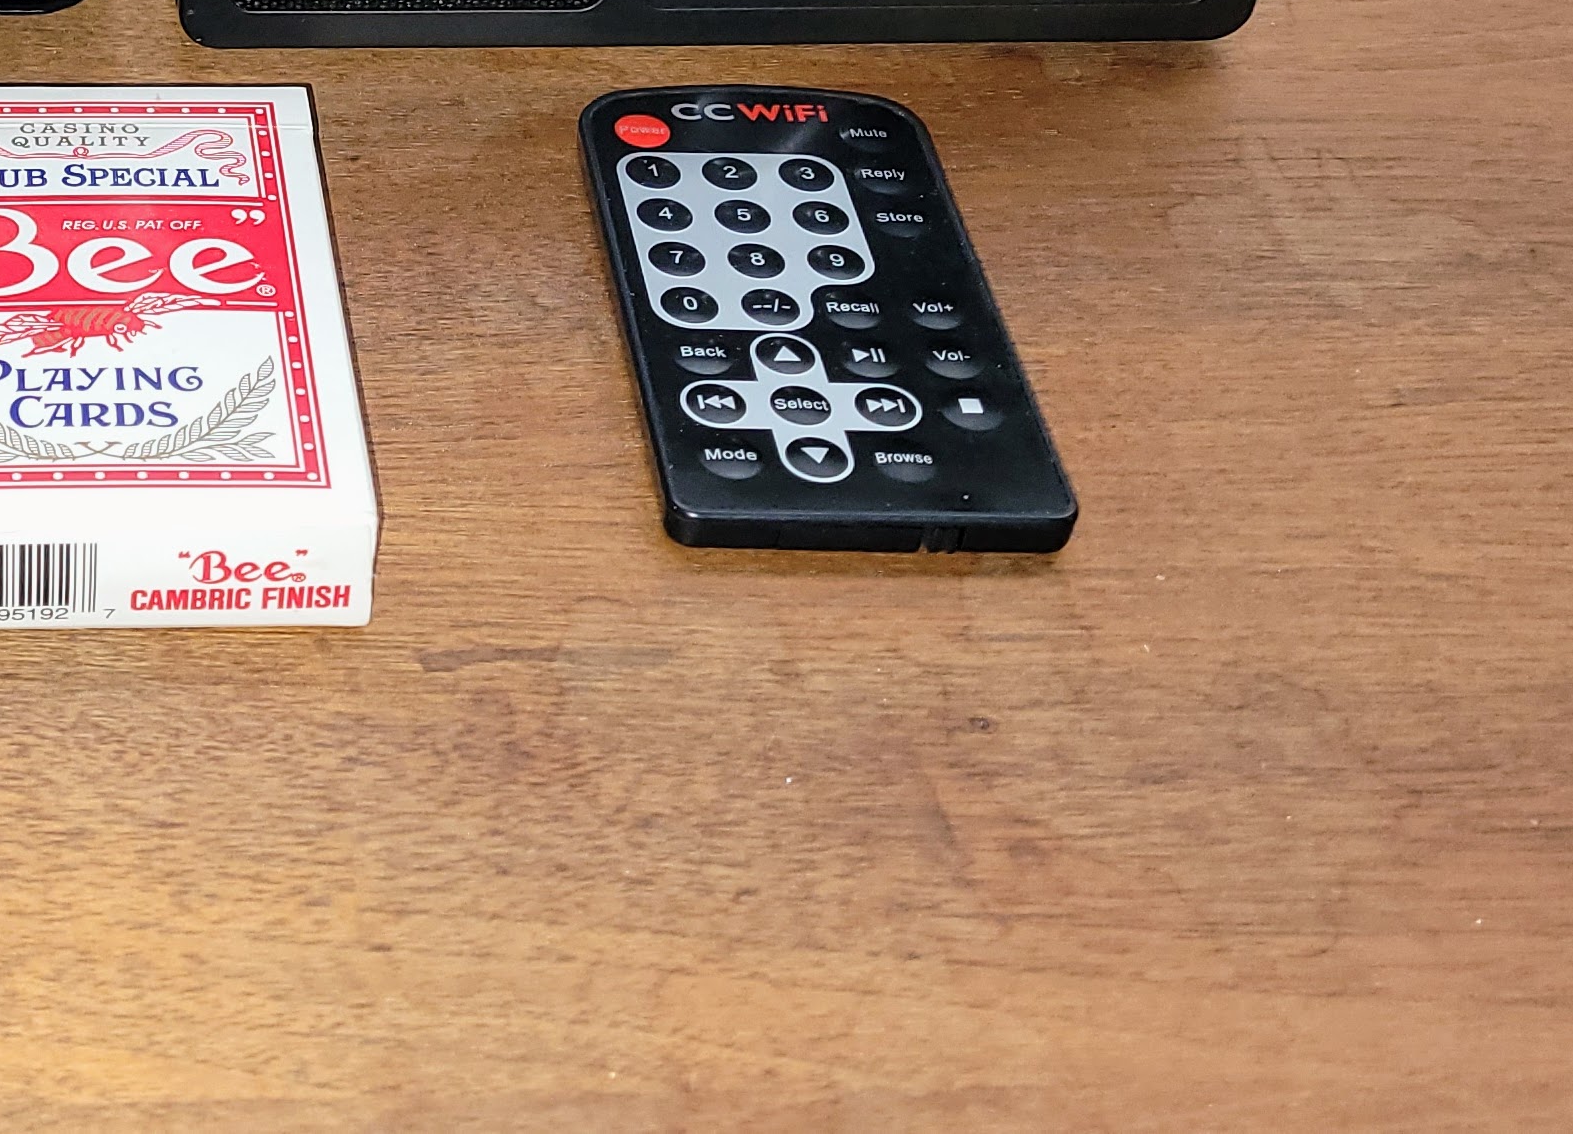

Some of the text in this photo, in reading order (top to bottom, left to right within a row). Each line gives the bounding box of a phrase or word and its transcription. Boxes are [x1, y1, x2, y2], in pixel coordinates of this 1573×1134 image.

[19, 122, 139, 135] CASINO
[619, 125, 665, 135] Power
[849, 128, 887, 138] Mute
[11, 136, 151, 149] QUALITY
[61, 163, 219, 188] SPECIAL
[648, 164, 815, 180] 1 2 3
[861, 169, 905, 181] Reply
[658, 206, 829, 223] 4 5 6
[876, 212, 924, 223] Store
[62, 219, 99, 230] REG.
[102, 219, 131, 230] U.S.
[669, 250, 845, 267] 7 8 9
[683, 296, 698, 311] 0
[826, 301, 879, 314] Recall
[913, 302, 954, 315] Vol+
[680, 345, 727, 359] Back
[933, 350, 971, 363] Vol-
[774, 397, 830, 412] Select
[9, 396, 179, 428] CARDS
[704, 448, 758, 461] Mode
[875, 451, 933, 465] Browse
[131, 585, 351, 611] CAMBRIC FINISH
[104, 607, 116, 620] 7
